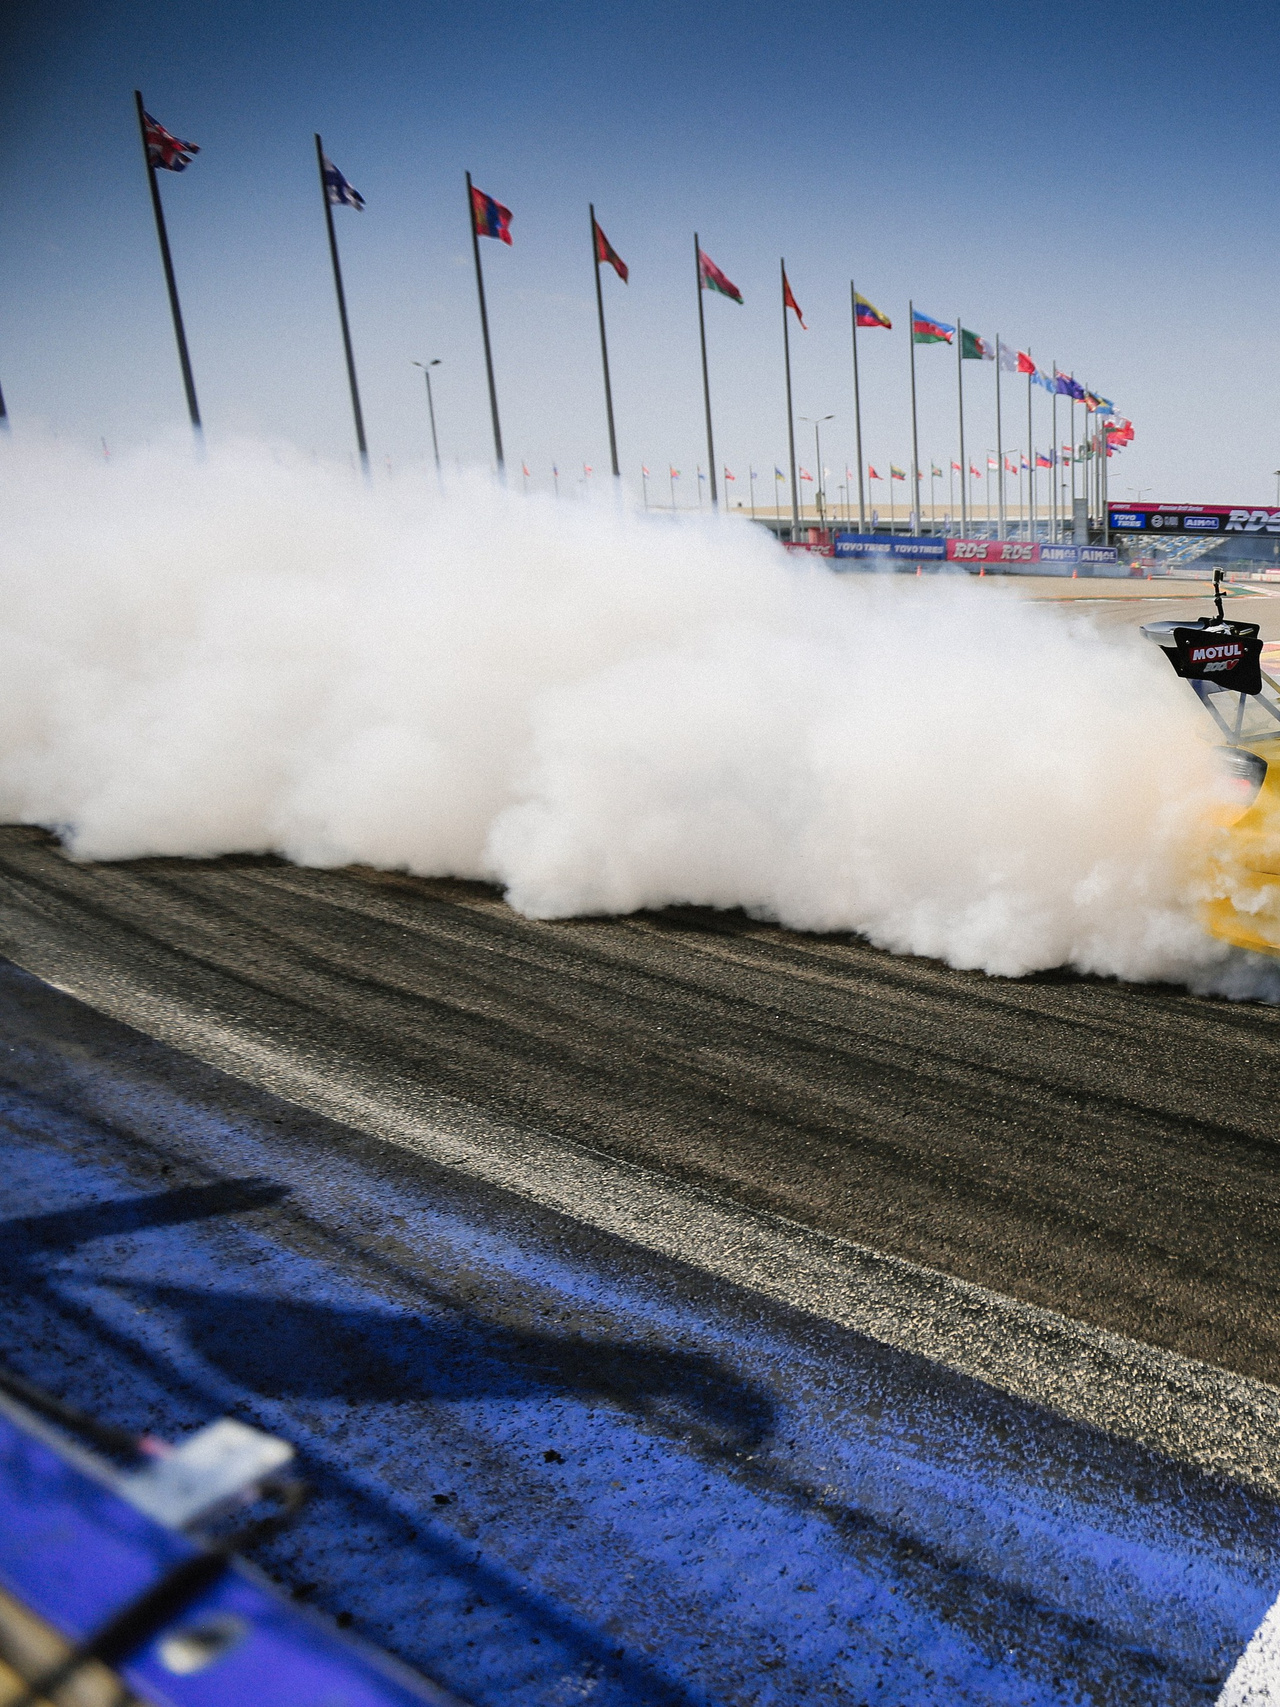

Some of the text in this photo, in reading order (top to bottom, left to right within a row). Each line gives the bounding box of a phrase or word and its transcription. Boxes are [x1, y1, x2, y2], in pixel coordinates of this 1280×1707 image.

[837, 542, 863, 551] TOYO
[894, 544, 918, 553] TOYO
[953, 542, 990, 559] RDS
[1001, 544, 1035, 560] RDS
[1192, 644, 1241, 660] MOTUL
